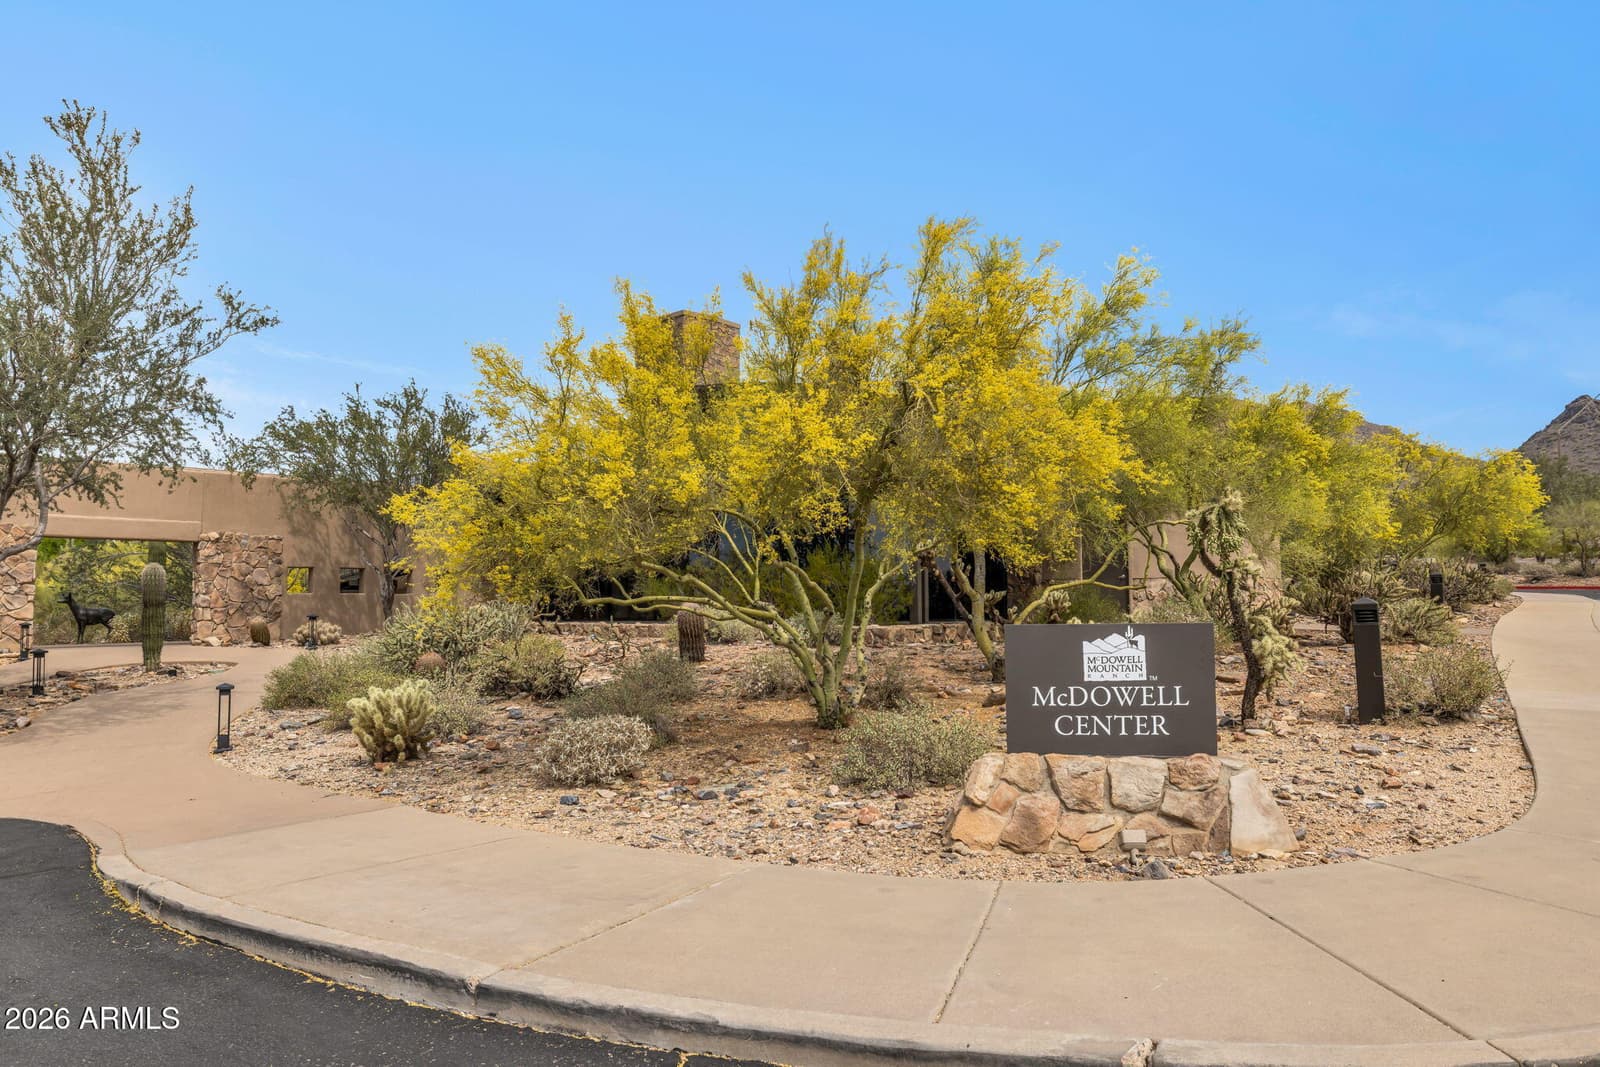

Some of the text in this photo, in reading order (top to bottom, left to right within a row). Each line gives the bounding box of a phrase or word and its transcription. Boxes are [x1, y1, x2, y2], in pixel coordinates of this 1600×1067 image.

[1087, 664, 1143, 673] MOUNTAIN
[1032, 686, 1190, 707] McDOWELL
[1054, 715, 1170, 736] CENTER
